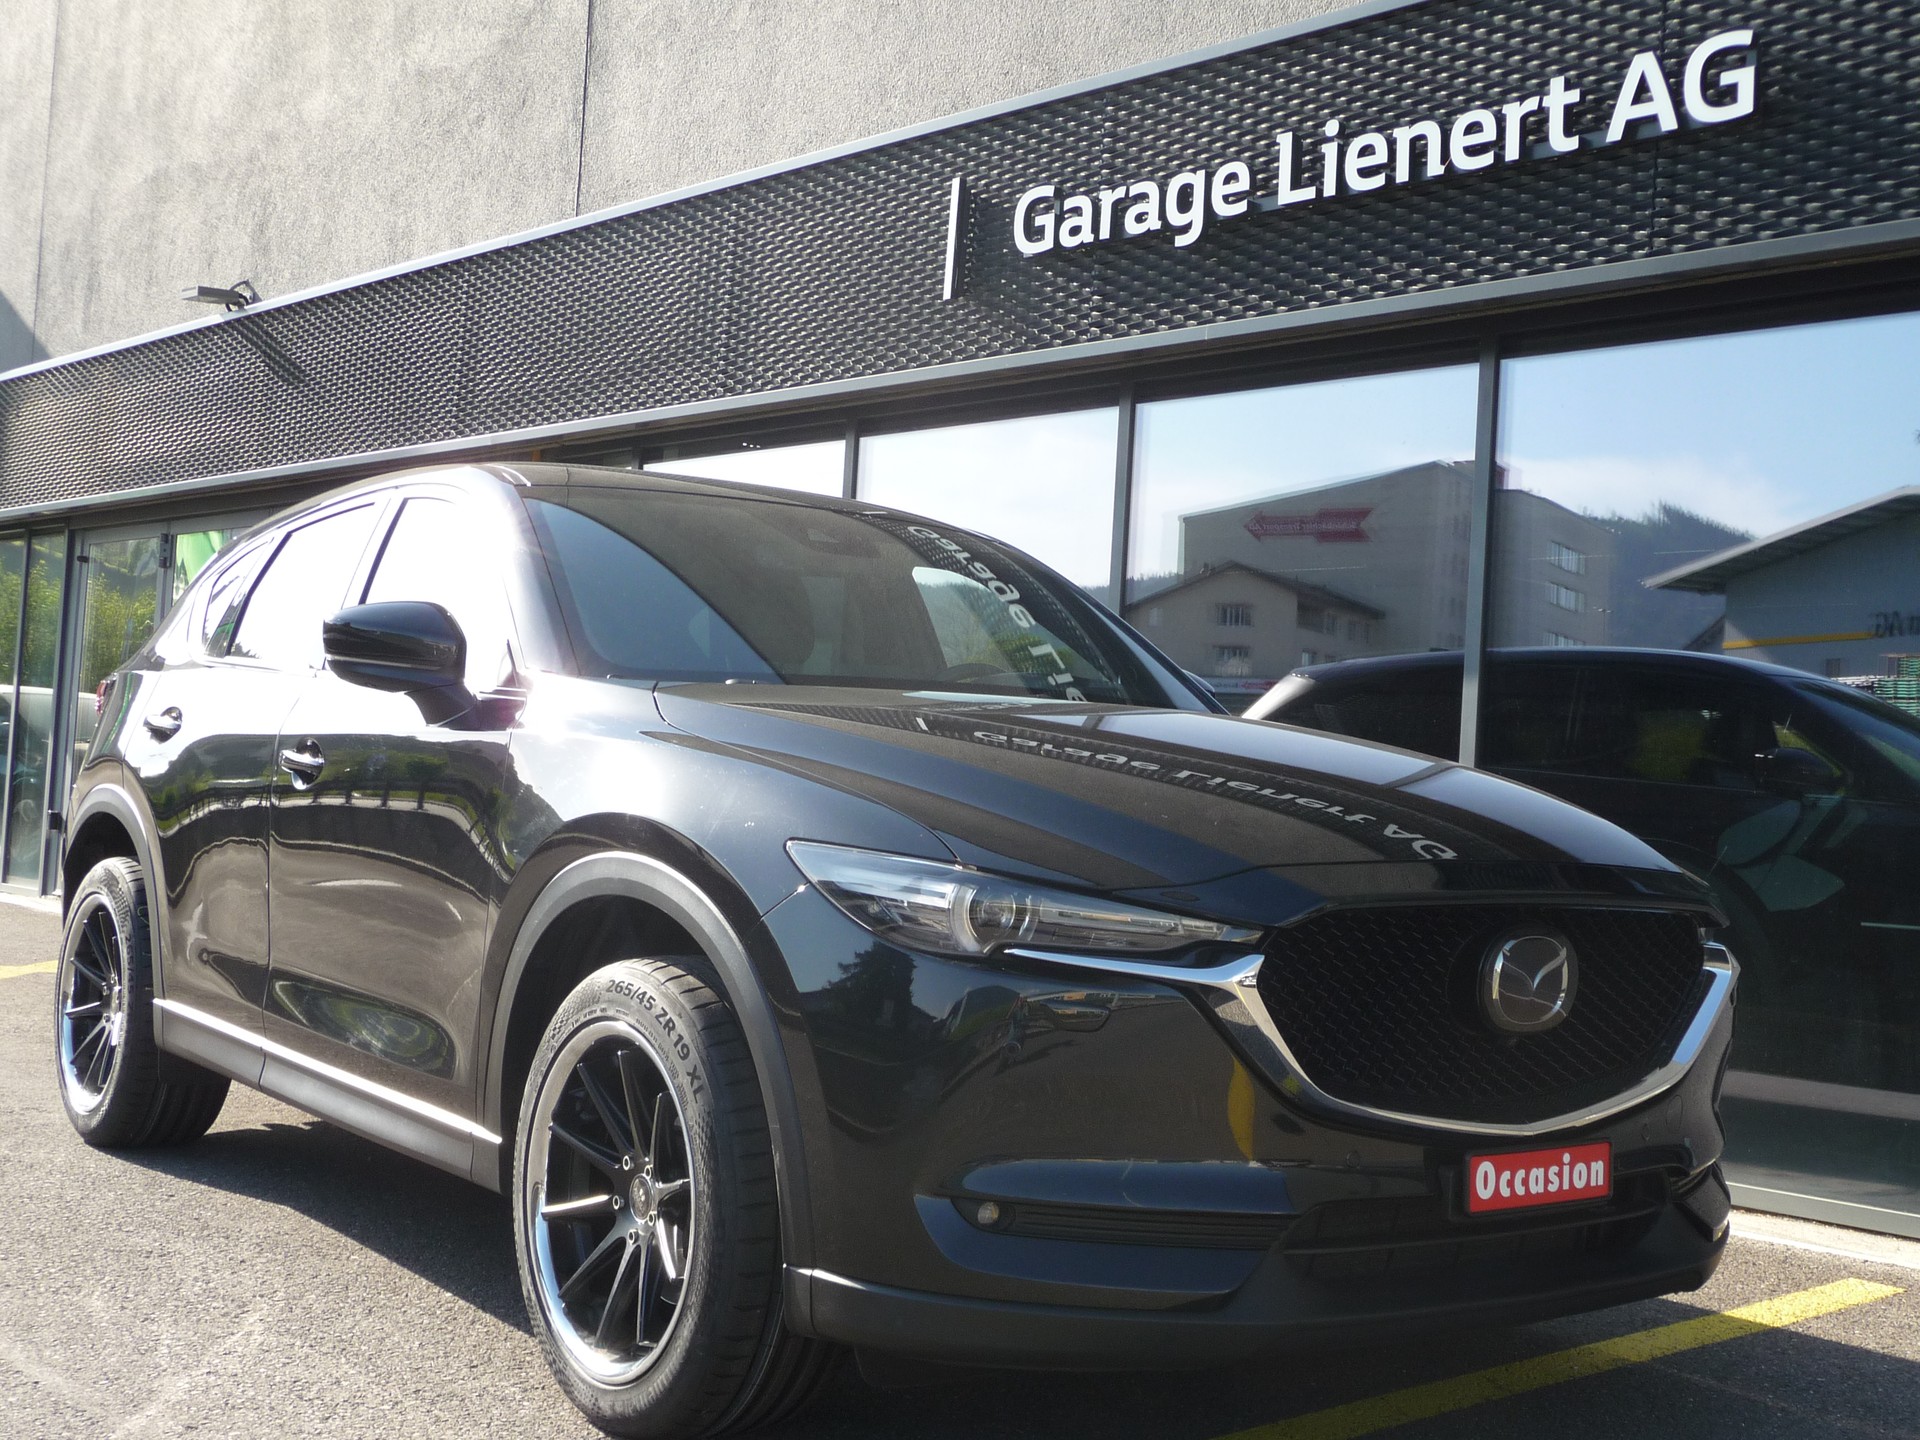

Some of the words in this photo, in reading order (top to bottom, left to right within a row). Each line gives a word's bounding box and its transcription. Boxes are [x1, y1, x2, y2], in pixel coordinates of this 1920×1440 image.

[1013, 160, 1251, 255] Garage
[1276, 76, 1581, 206] Lienert
[1605, 29, 1756, 143] AG
[605, 979, 657, 1011] 265/45
[654, 1006, 677, 1038] ZR
[672, 1034, 691, 1061] 19
[686, 1064, 702, 1104] XL
[1475, 1152, 1604, 1200] Occasion
